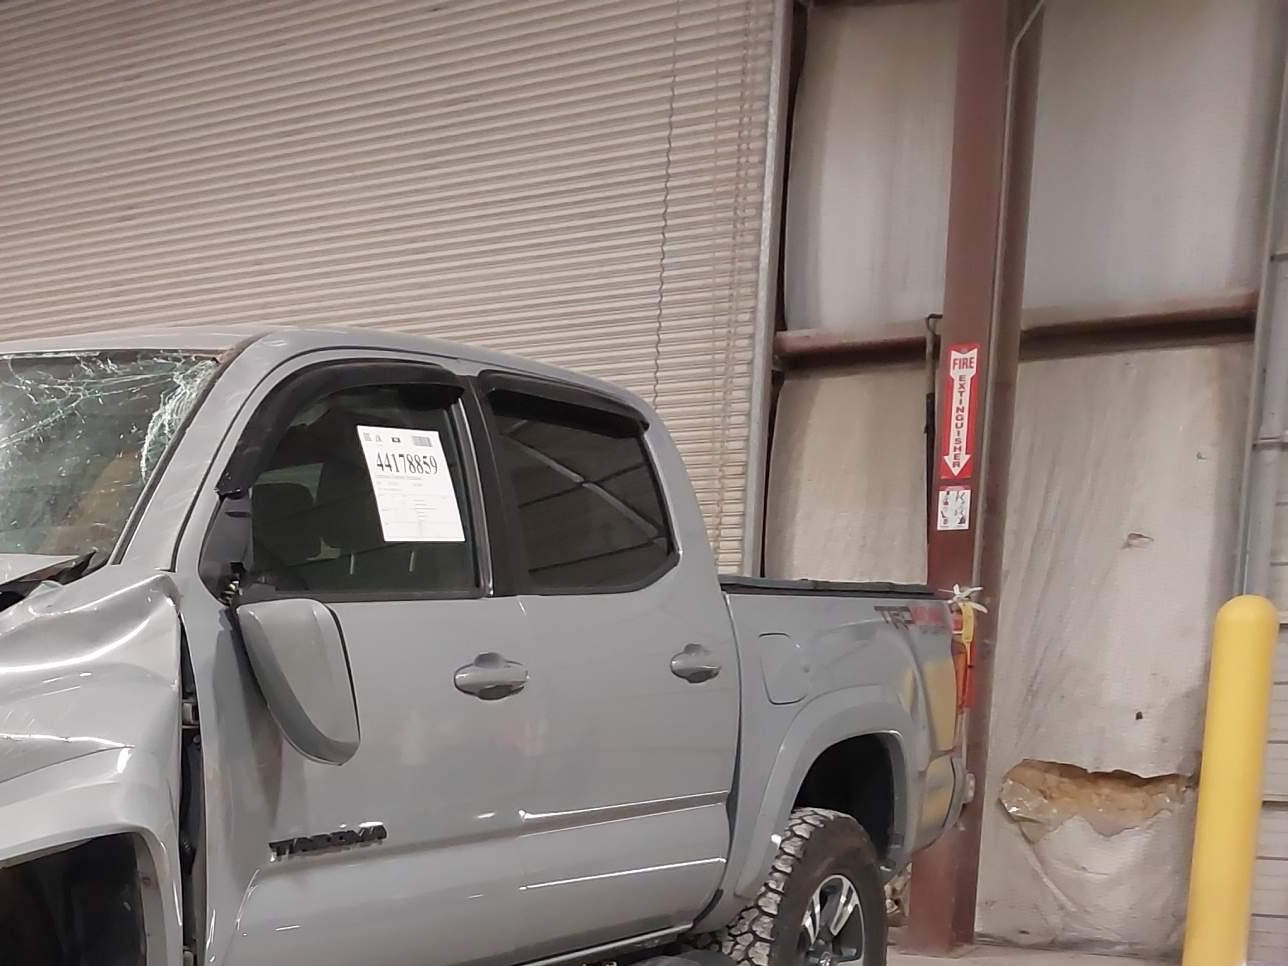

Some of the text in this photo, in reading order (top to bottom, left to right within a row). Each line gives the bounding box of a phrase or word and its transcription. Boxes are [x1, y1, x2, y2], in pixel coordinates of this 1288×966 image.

[952, 356, 975, 371] FIRE
[951, 374, 966, 469] EXTINGUISHER
[376, 452, 438, 475] 44178859
[268, 821, 387, 858] TACOMA
